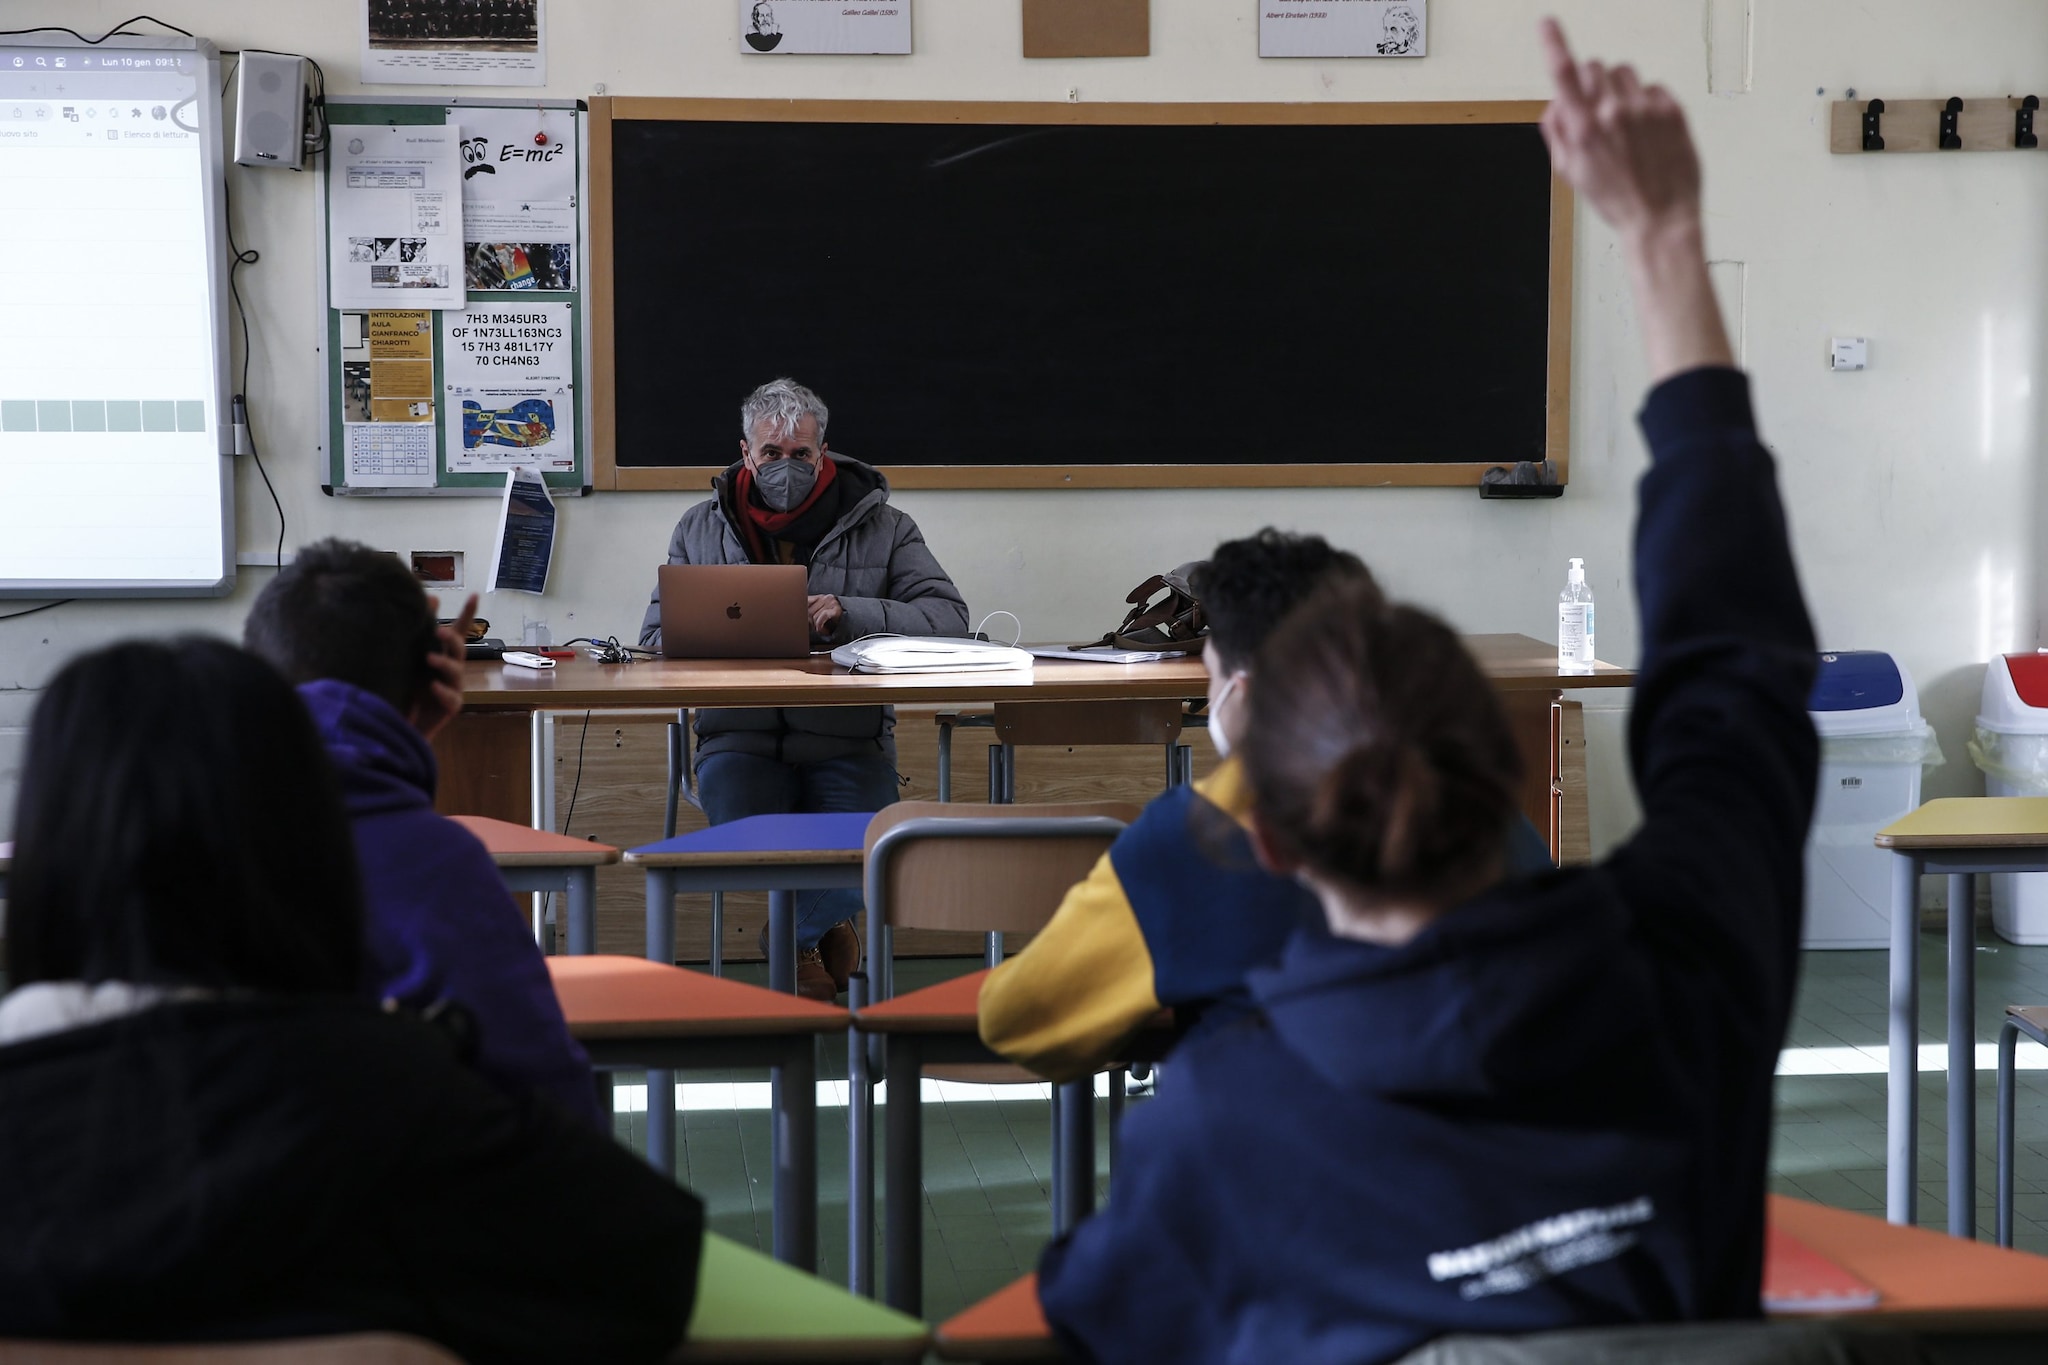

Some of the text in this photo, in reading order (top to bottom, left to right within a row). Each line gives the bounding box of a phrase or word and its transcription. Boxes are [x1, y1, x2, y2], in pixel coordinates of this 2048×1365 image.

[102, 57, 118, 67] Lun
[121, 57, 133, 67] 10
[135, 59, 151, 69] gen
[0, 130, 39, 138] uovo sito
[124, 131, 189, 139] Elenco di lettura
[510, 276, 536, 290] change
[466, 314, 547, 324] 7H3 M345UR3
[452, 328, 562, 338] OF 1N73LL163NC3
[461, 342, 554, 352] 15 7H3 481L17Y
[475, 356, 540, 366] 70 CH4N63
